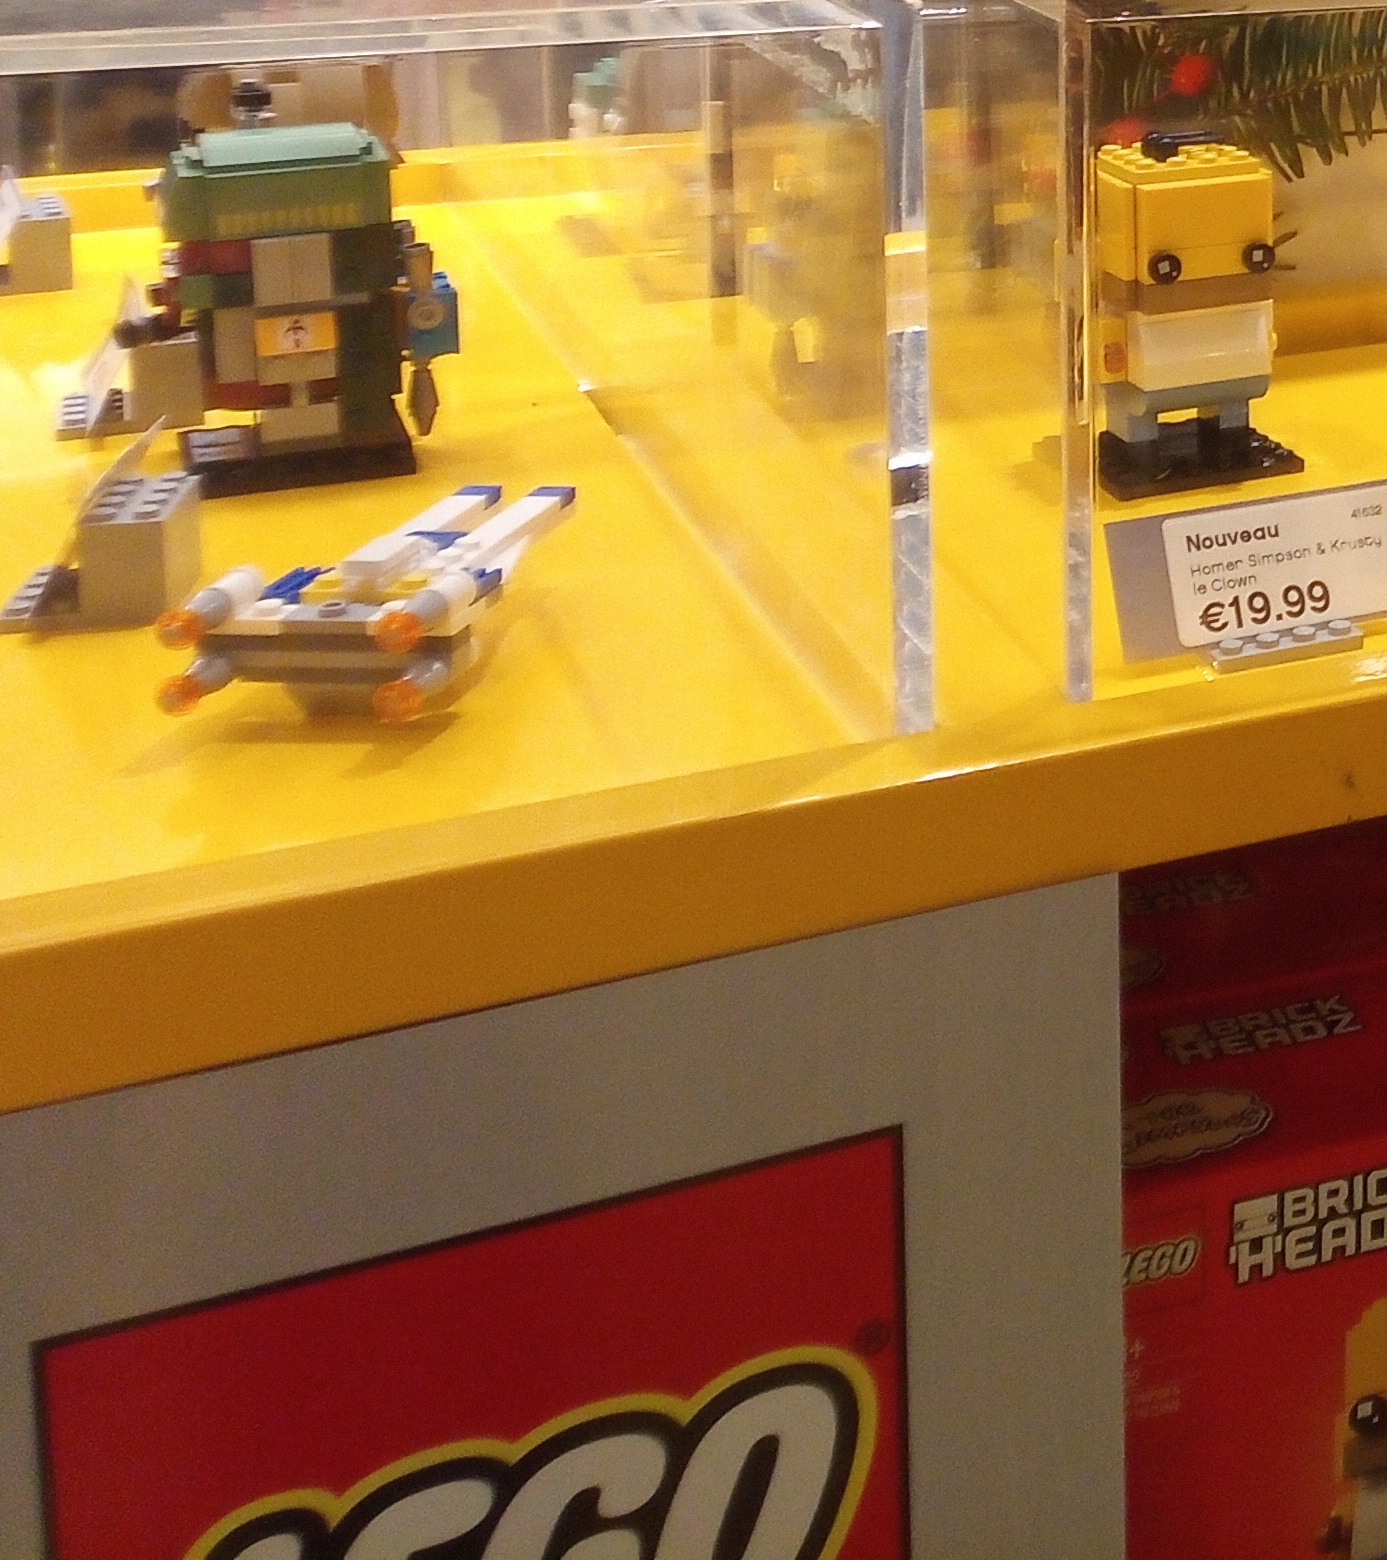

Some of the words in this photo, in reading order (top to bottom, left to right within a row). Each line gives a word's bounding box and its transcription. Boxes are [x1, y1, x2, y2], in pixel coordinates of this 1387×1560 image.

[1185, 524, 1280, 553] Nouveau
[1190, 557, 1243, 578] Homer
[1247, 546, 1311, 568] Simpson
[1316, 542, 1326, 555] &
[1330, 535, 1383, 553] Krusty
[1192, 582, 1207, 596] le
[1210, 573, 1258, 592] Clown
[1198, 579, 1331, 633] €19.99
[1206, 994, 1350, 1038] BRICK
[1163, 1011, 1364, 1066] HEADZ
